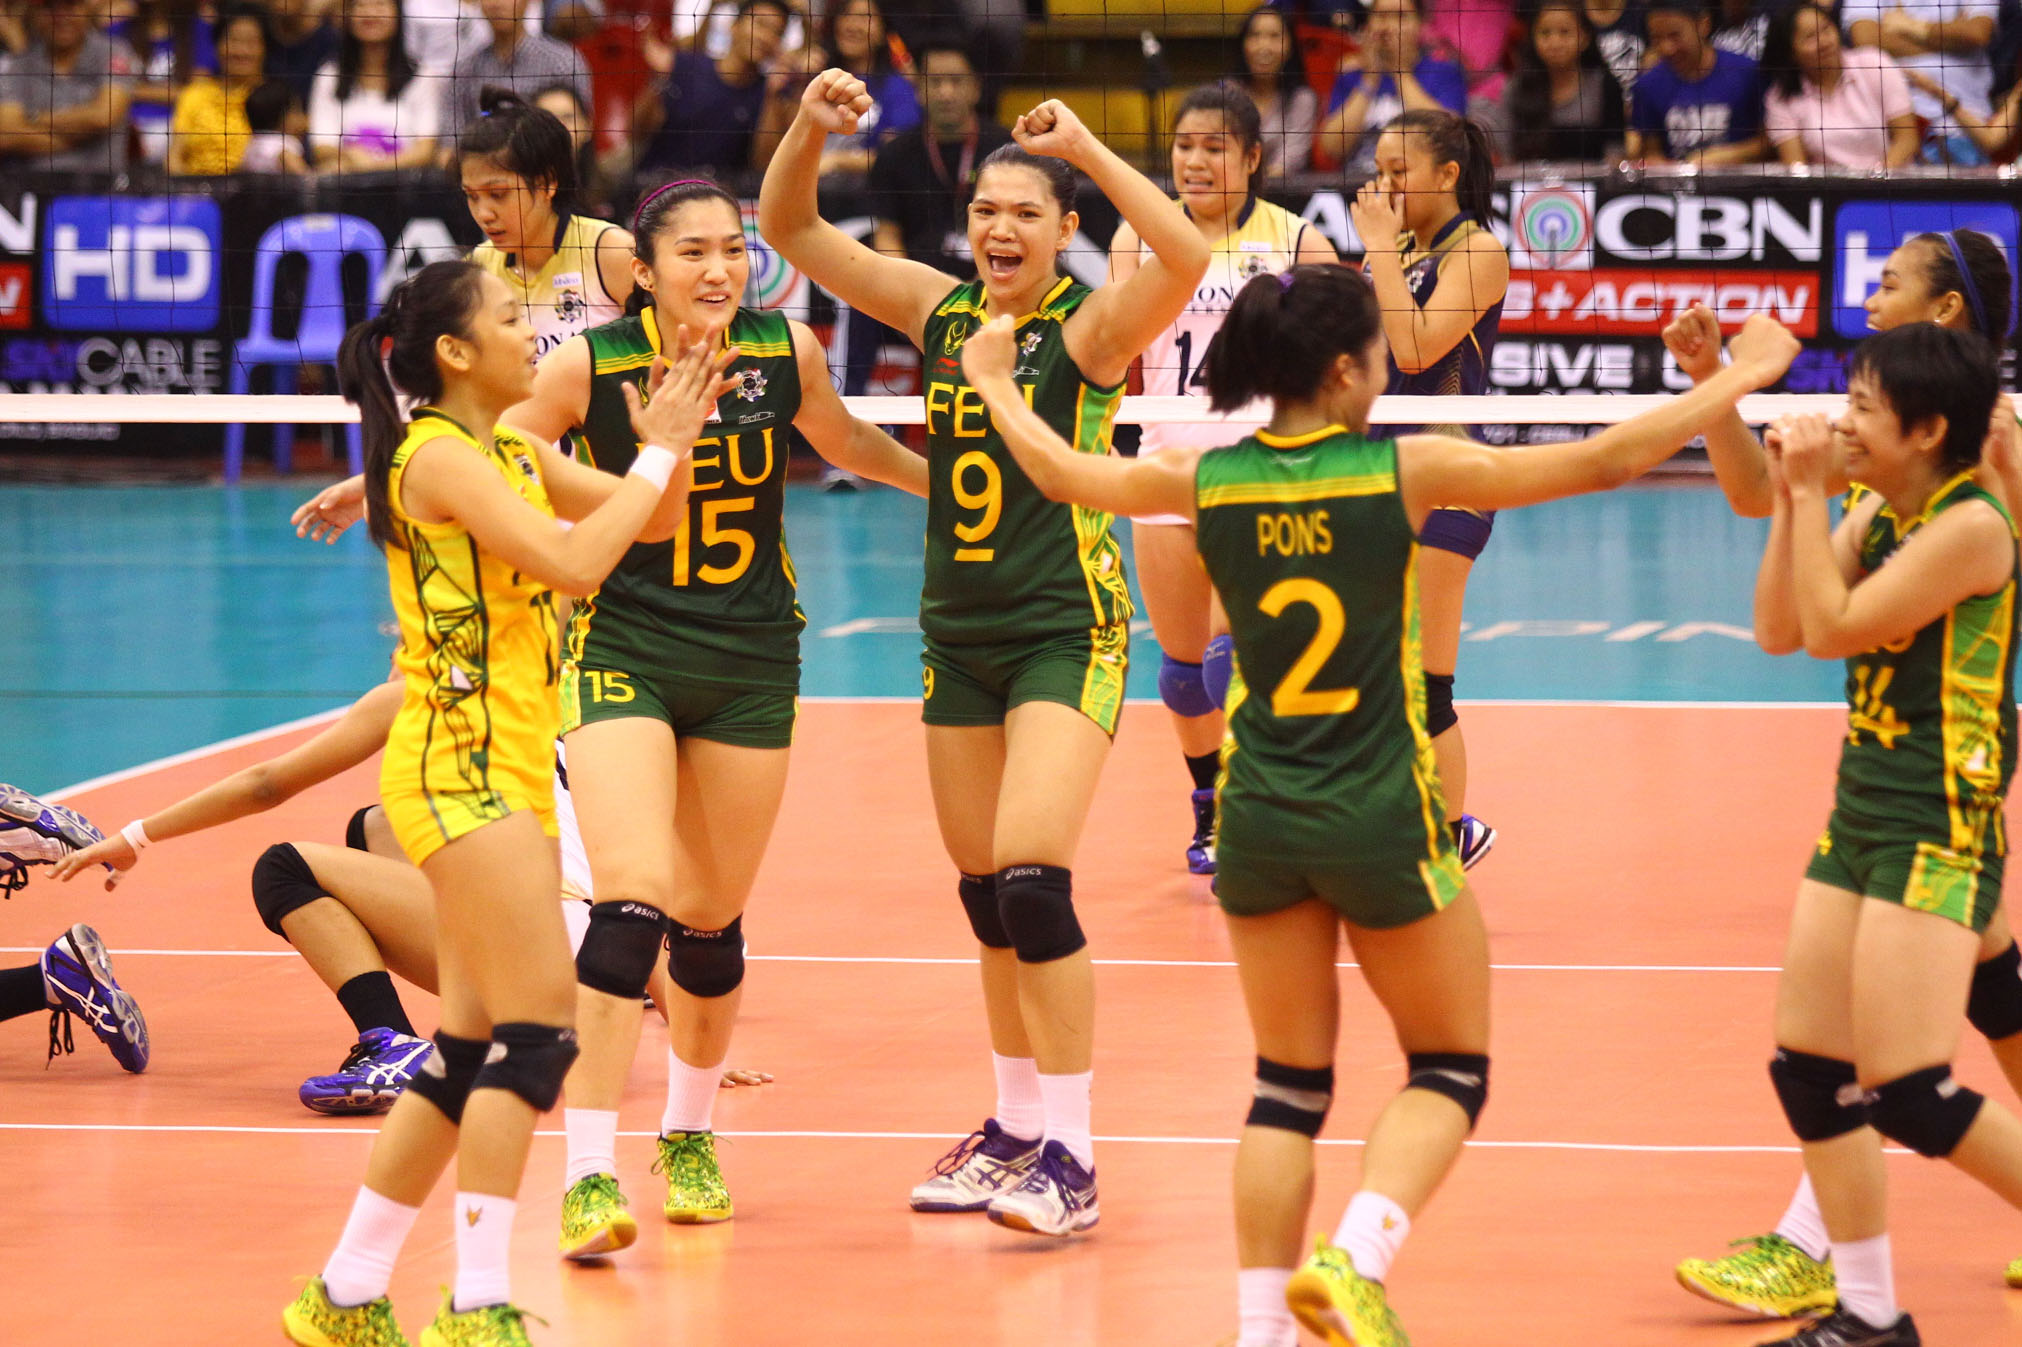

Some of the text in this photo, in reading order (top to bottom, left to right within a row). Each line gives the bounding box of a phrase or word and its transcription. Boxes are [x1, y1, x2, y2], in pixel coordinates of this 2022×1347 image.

[53, 223, 213, 302] HD
[1595, 195, 1823, 262] CBN
[636, 427, 774, 492] EU
[952, 450, 1002, 543] 9
[1257, 509, 1334, 557] PONS
[672, 496, 756, 586] 15
[1258, 577, 1359, 717] 2
[585, 670, 636, 703] 15
